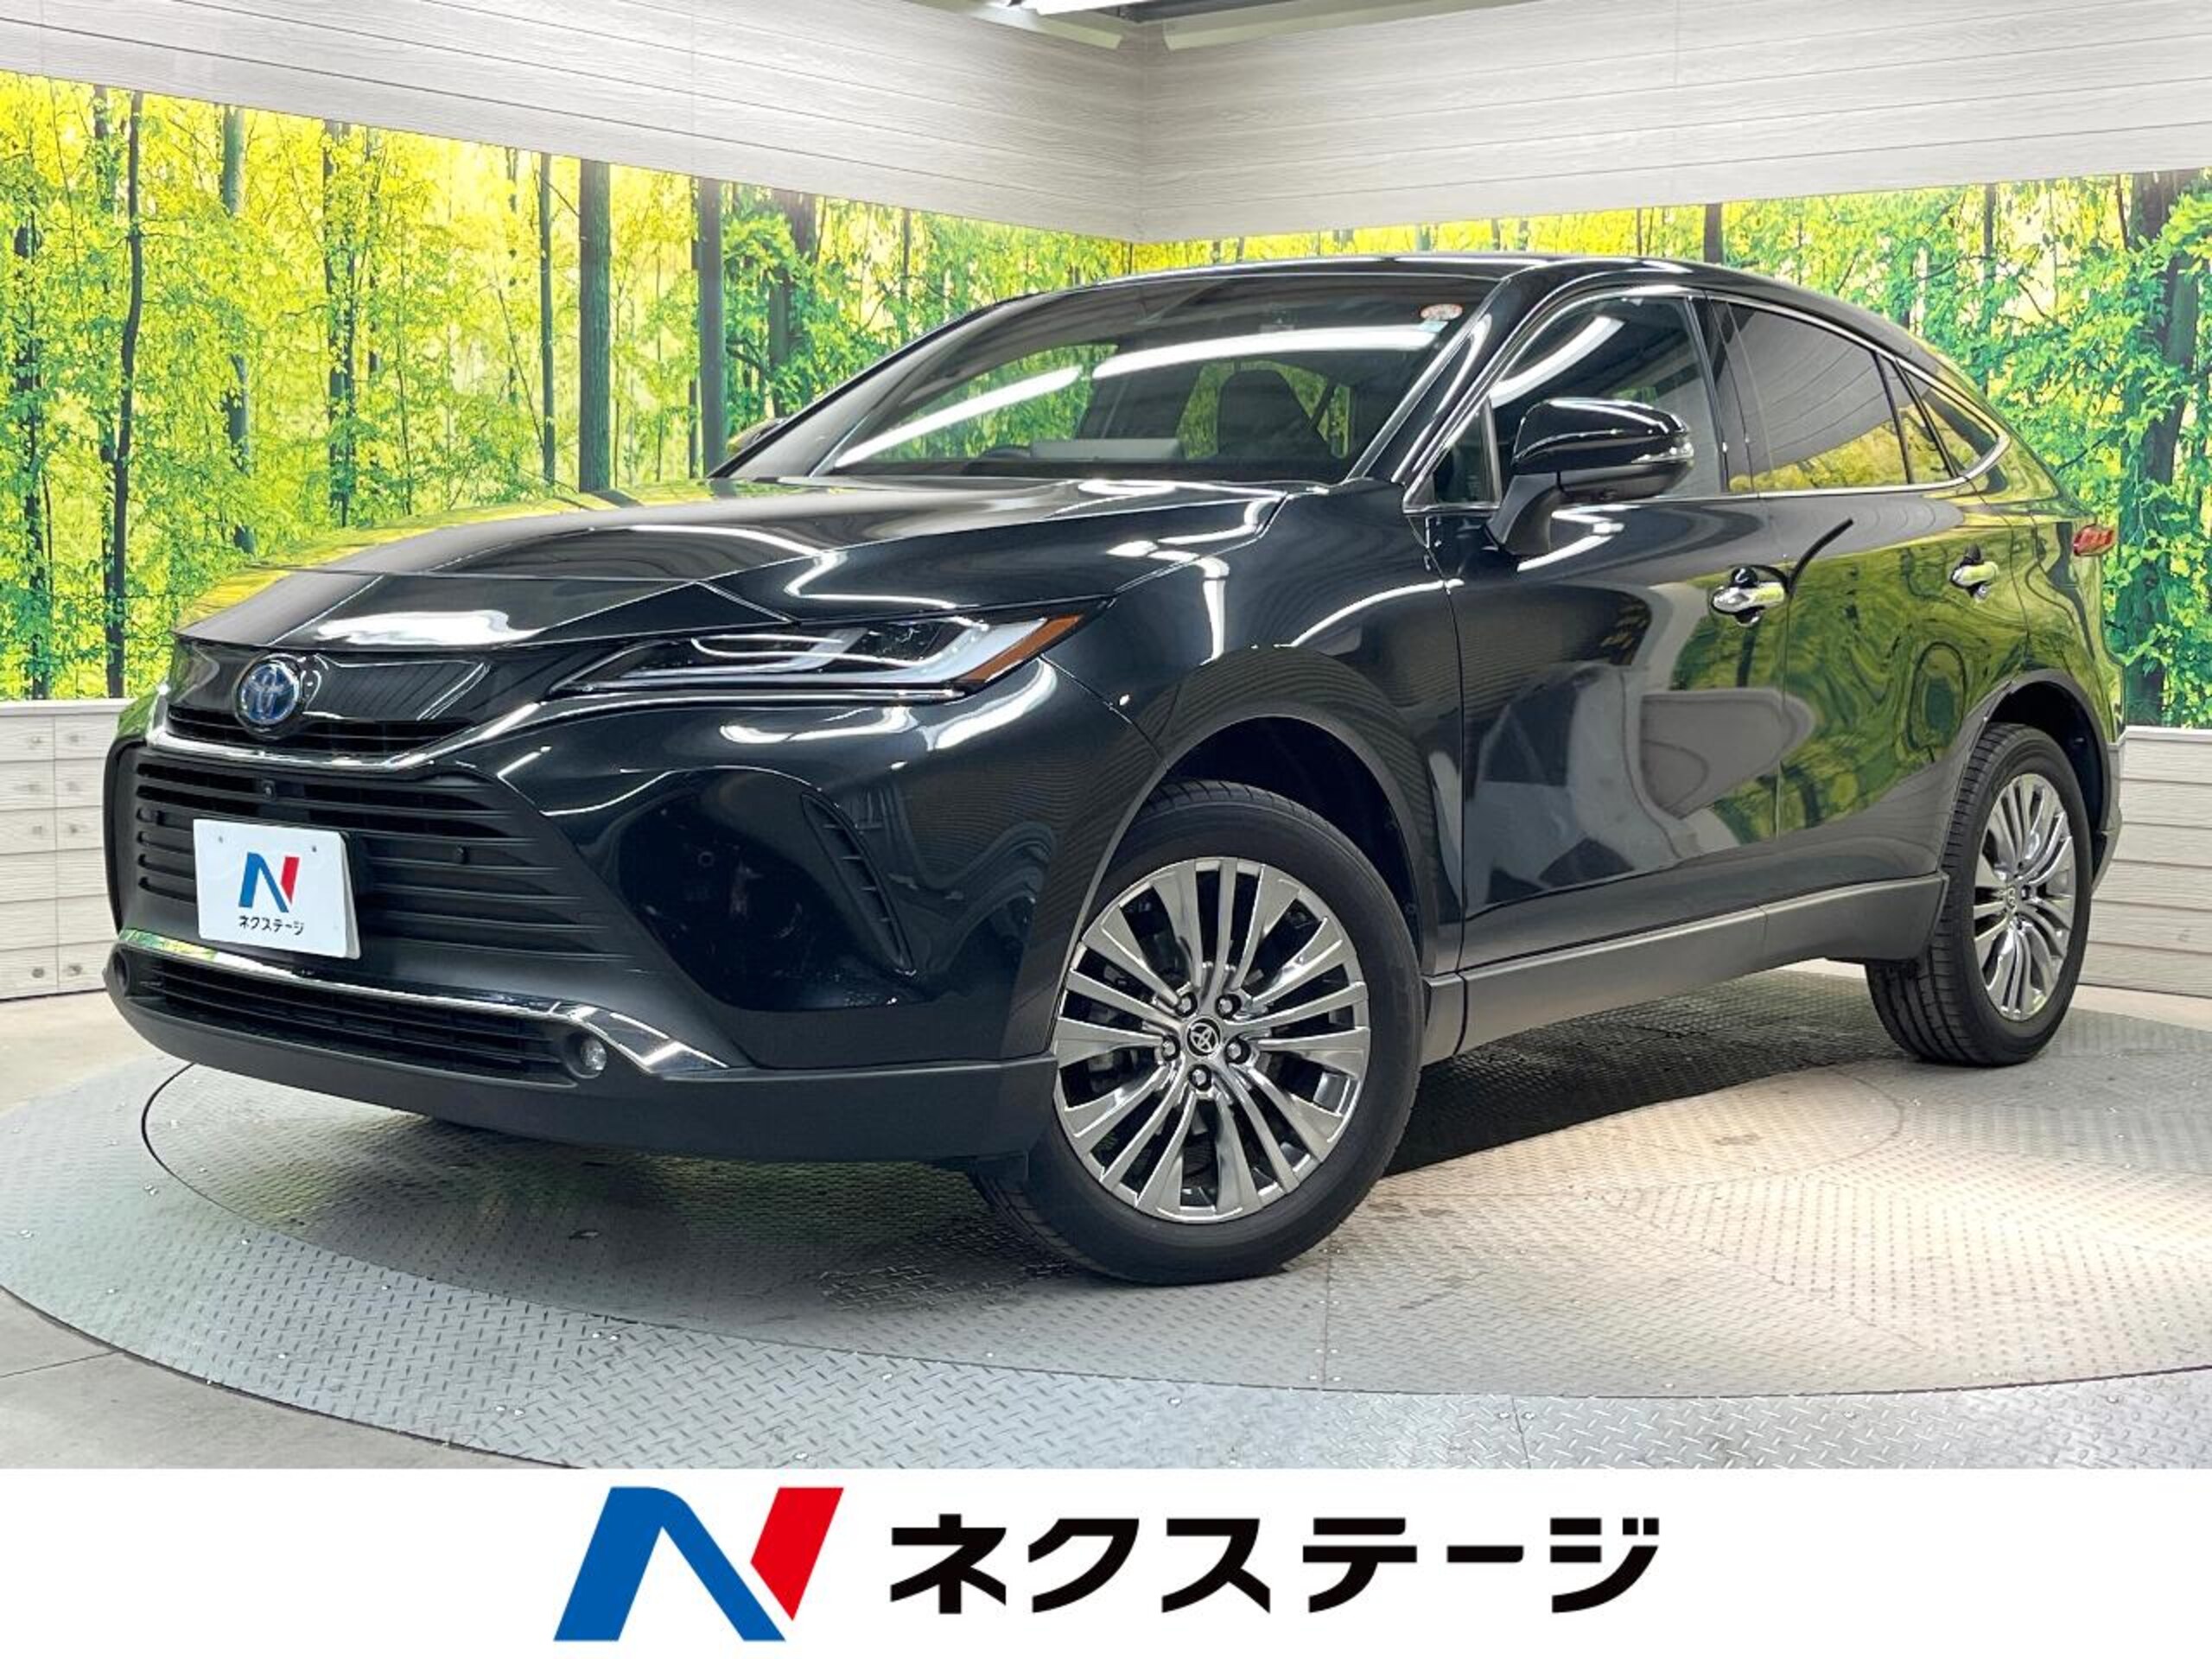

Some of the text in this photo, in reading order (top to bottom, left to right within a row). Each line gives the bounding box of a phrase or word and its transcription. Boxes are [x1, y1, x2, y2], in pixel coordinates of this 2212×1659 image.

[238, 852, 300, 912] N
[238, 915, 303, 936] ネクステージ
